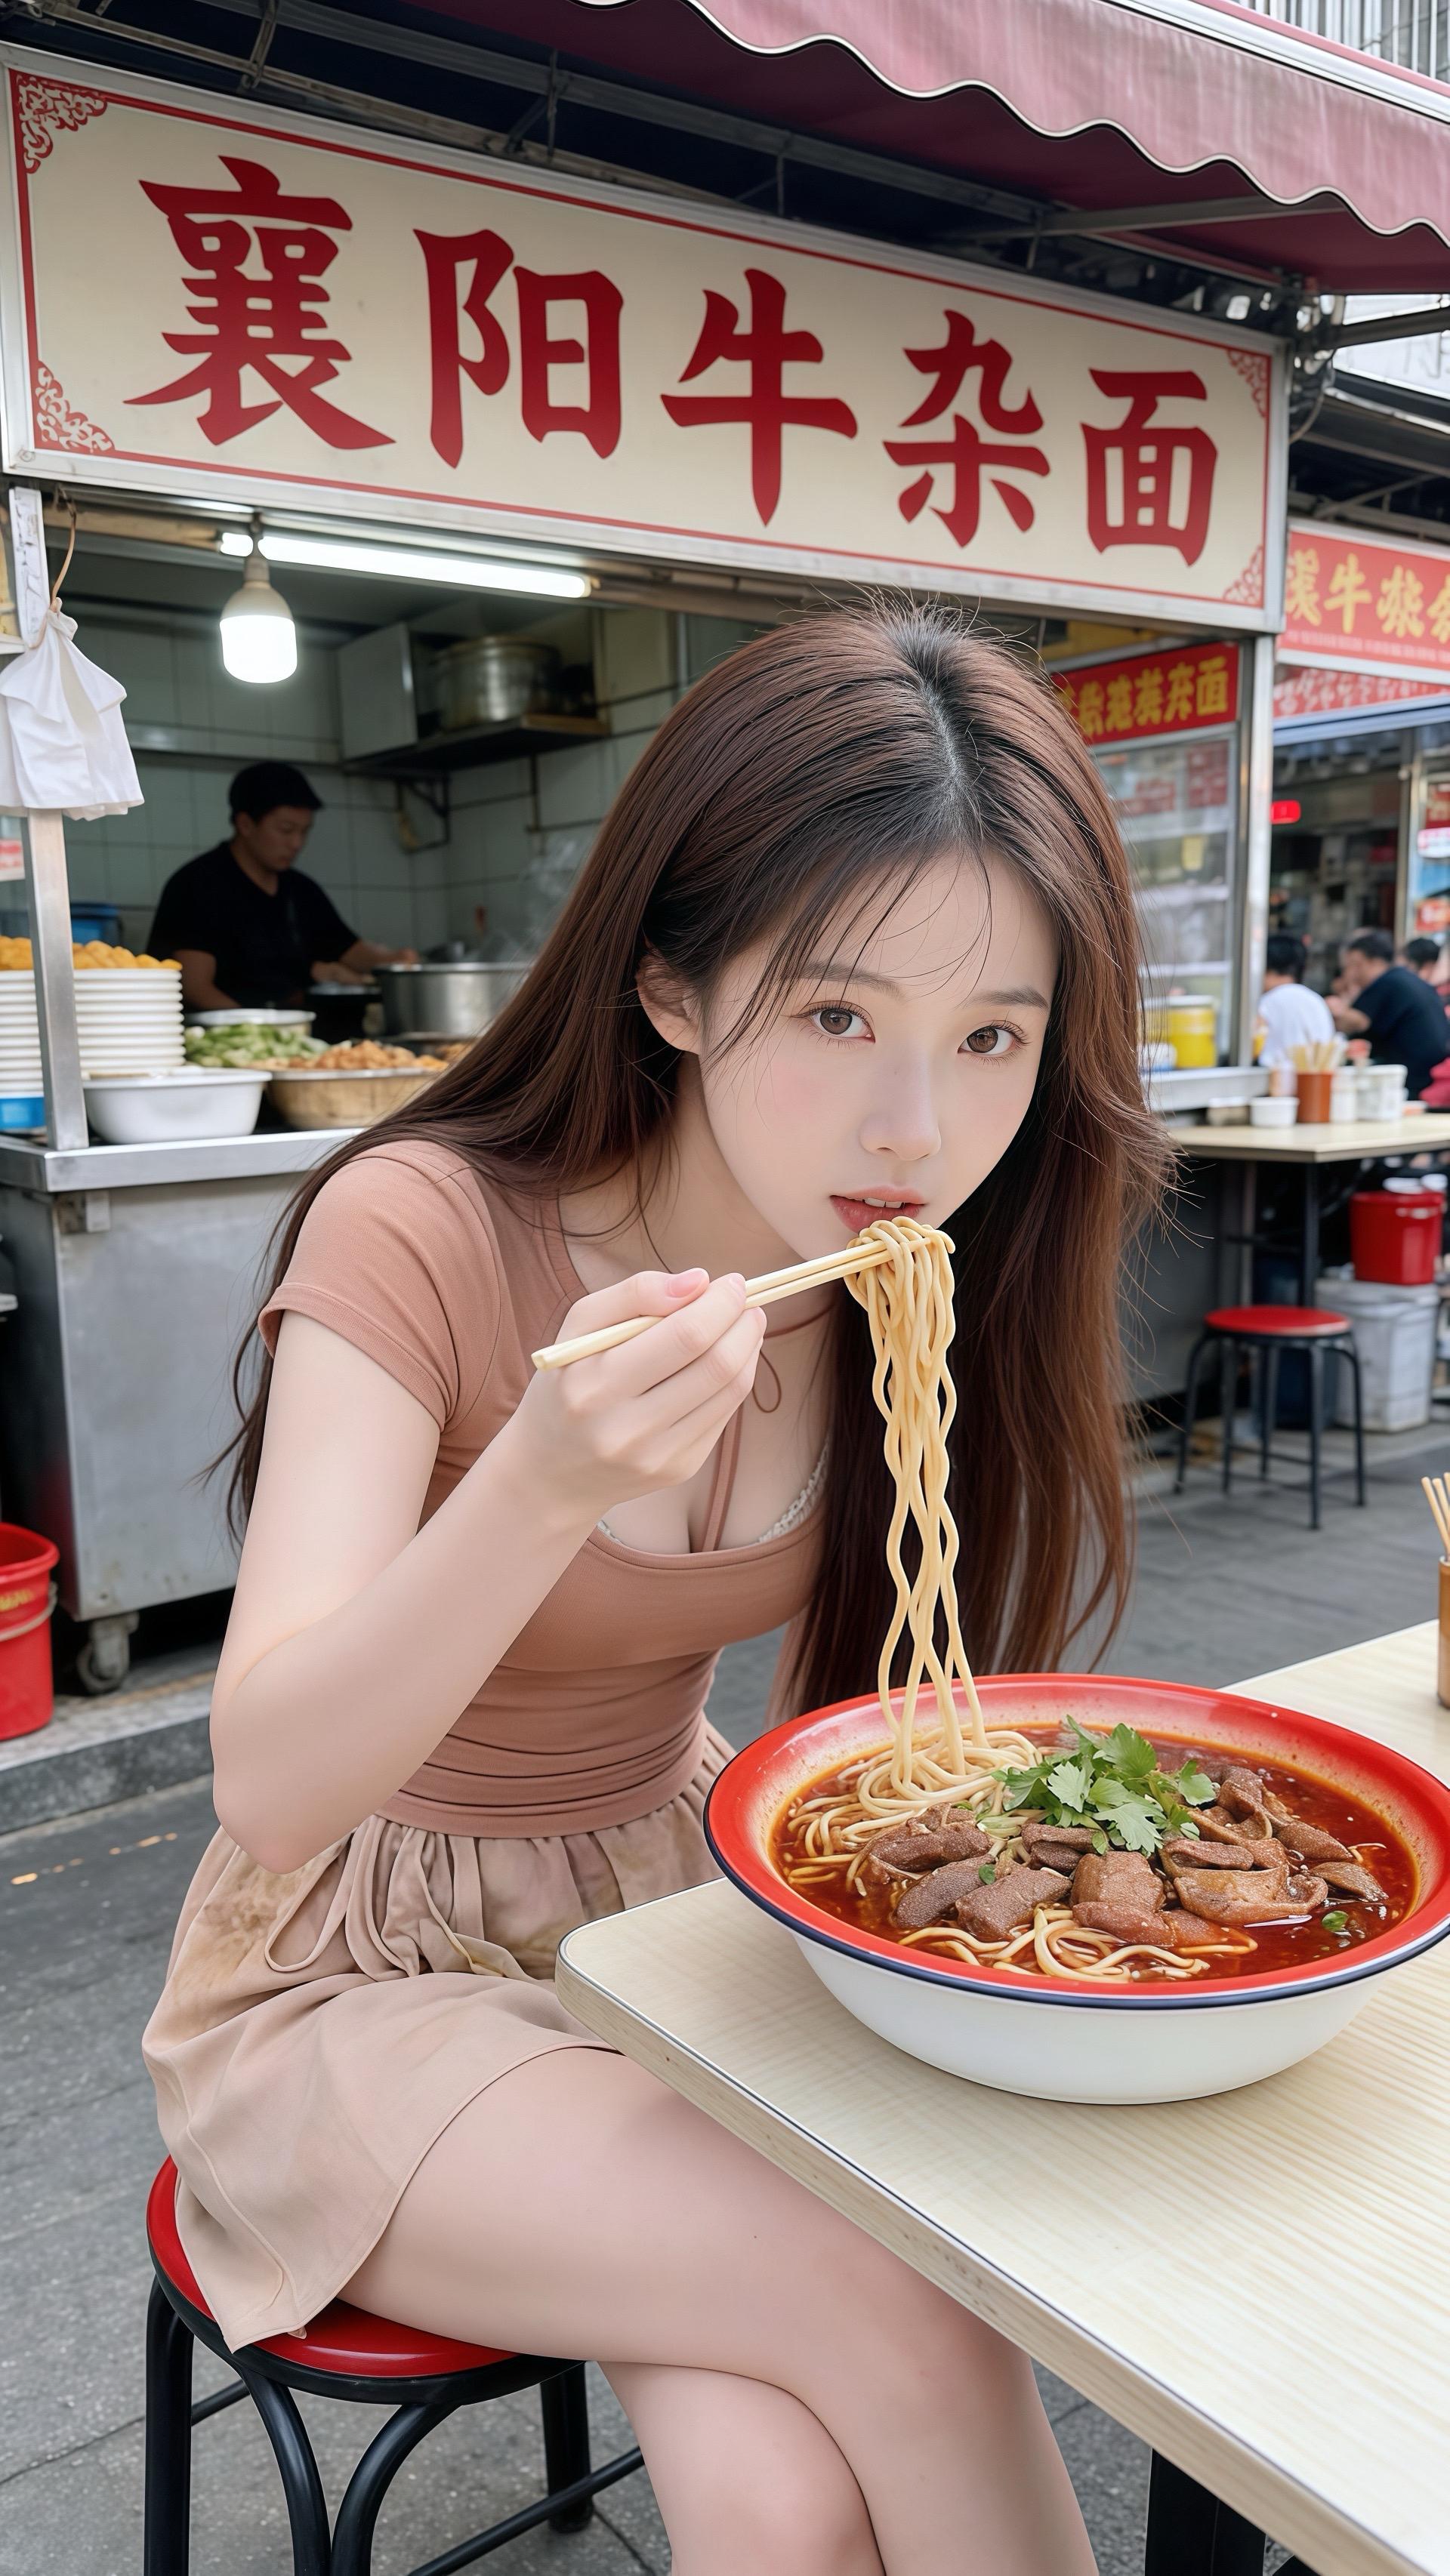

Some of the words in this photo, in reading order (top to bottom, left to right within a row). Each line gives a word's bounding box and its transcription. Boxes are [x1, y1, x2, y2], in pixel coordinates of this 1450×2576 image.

[125, 156, 1217, 565] 襄阳牛杂面
